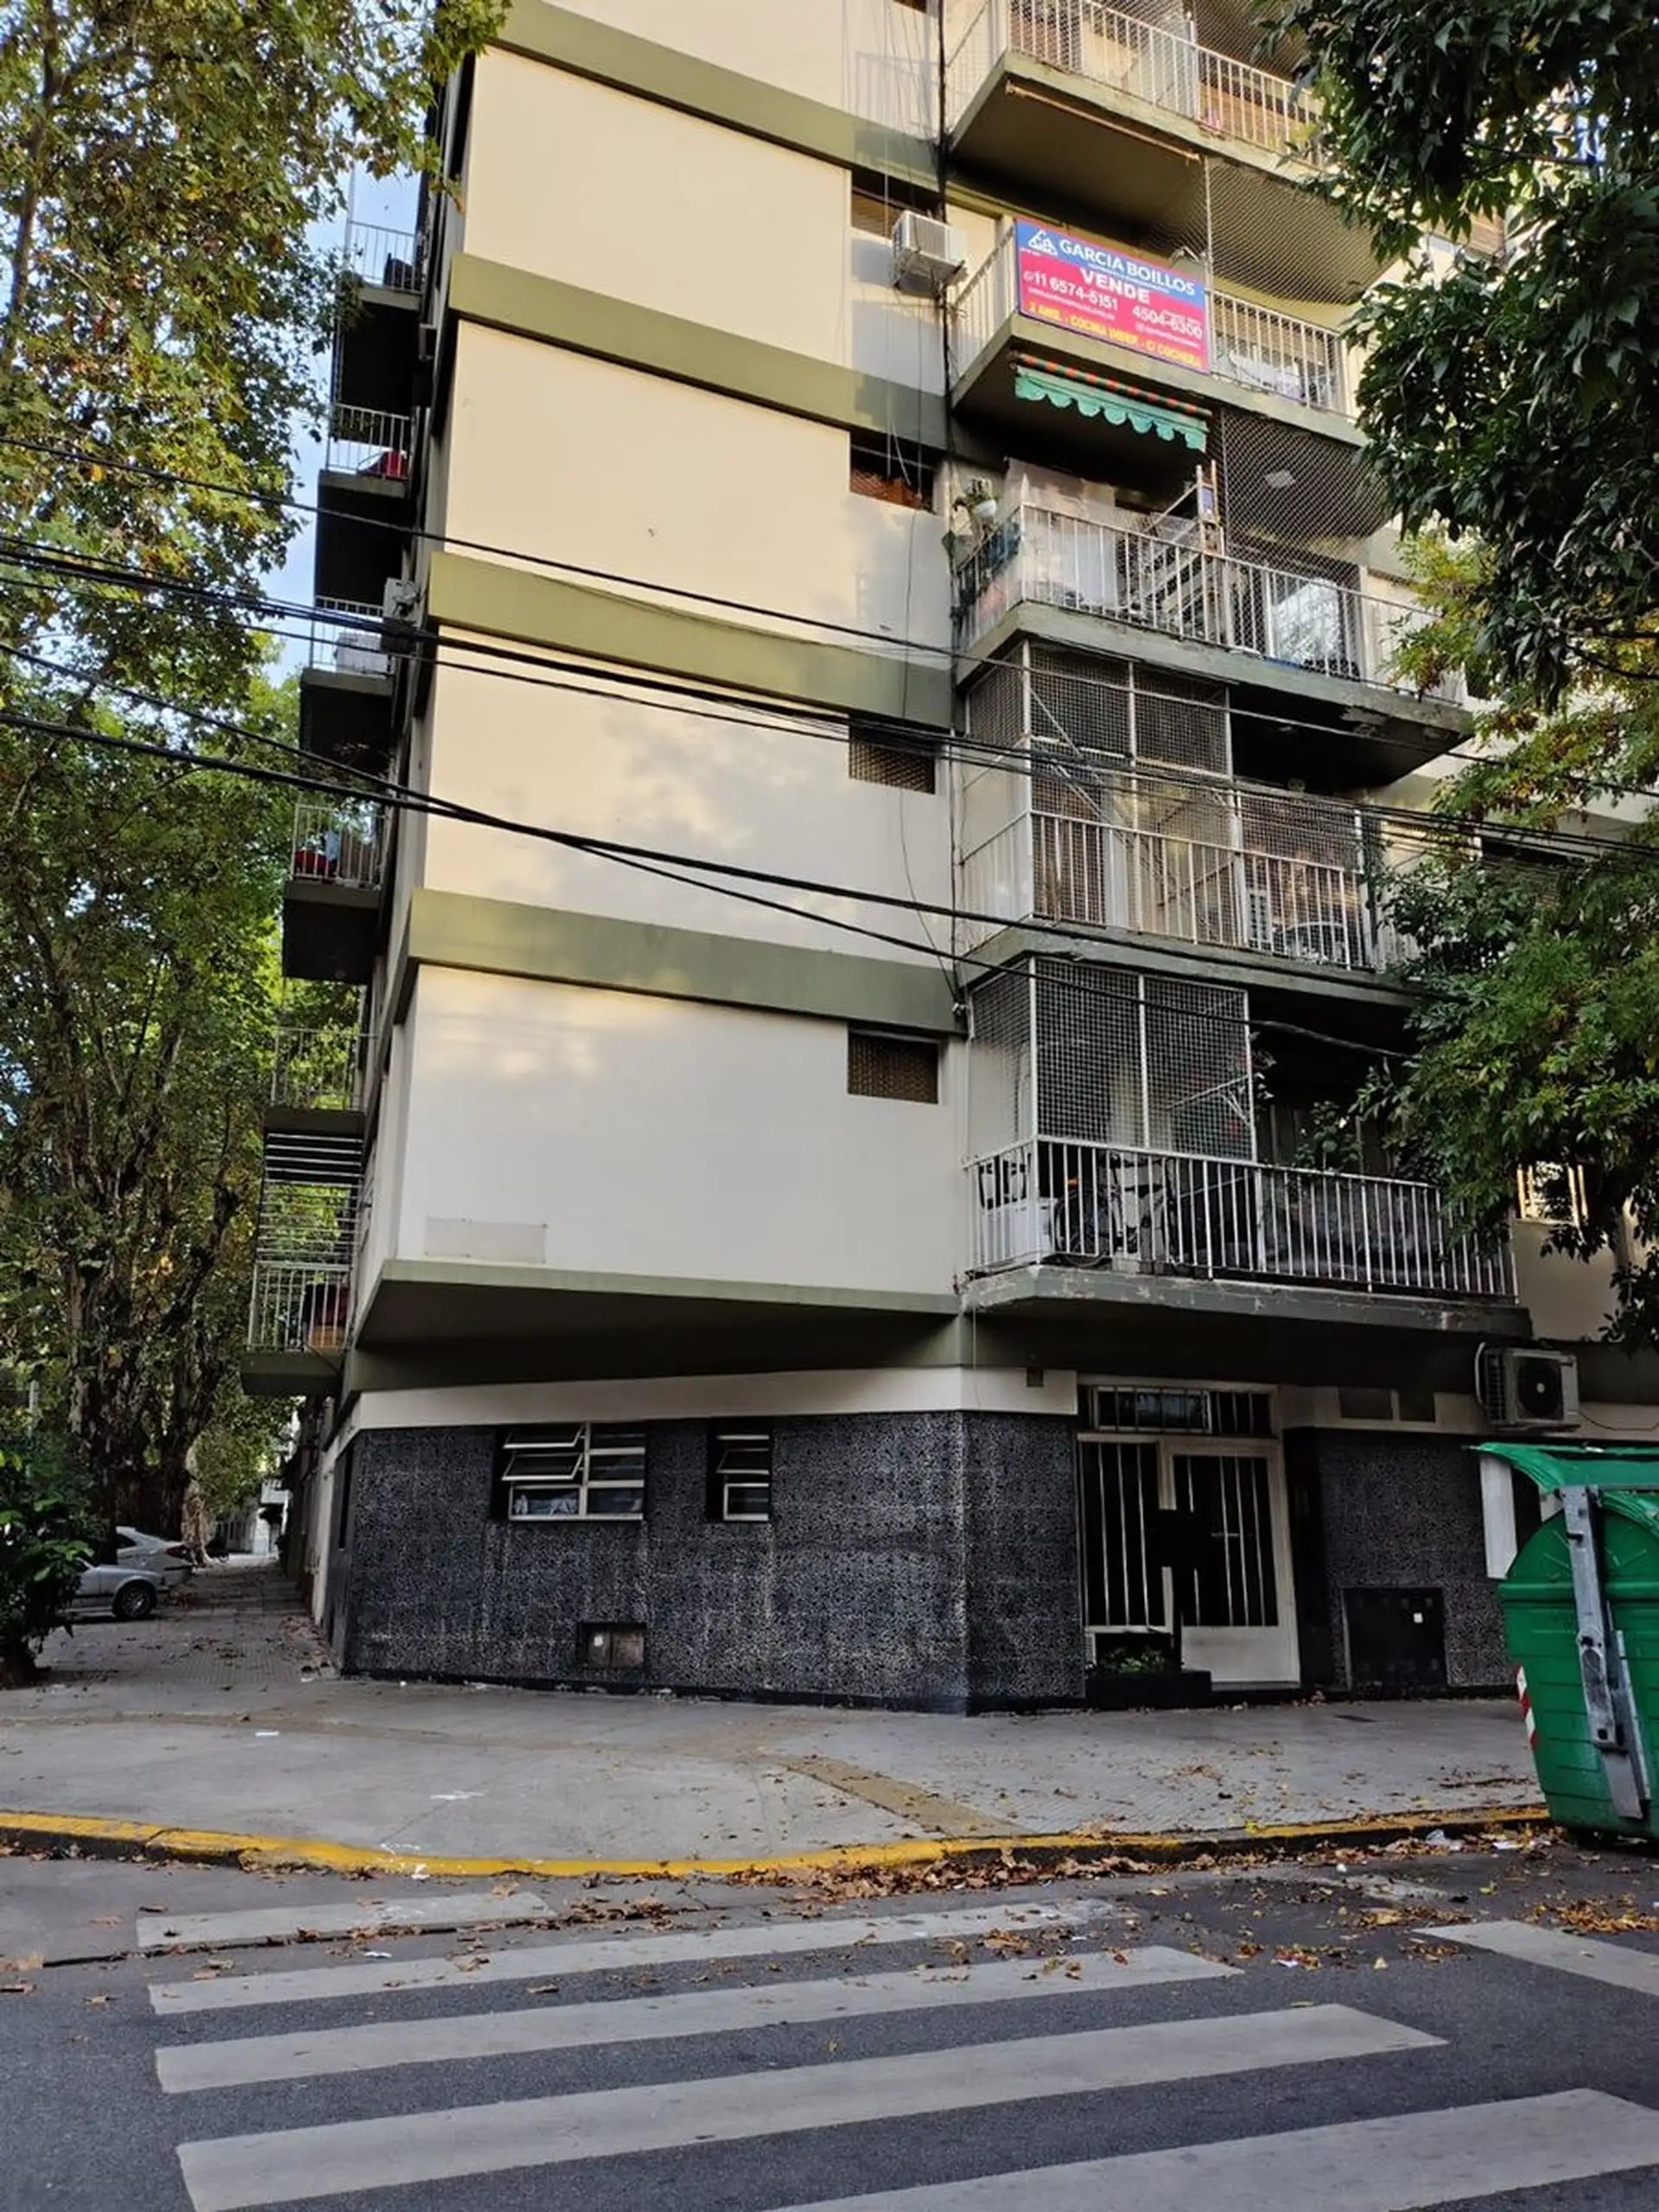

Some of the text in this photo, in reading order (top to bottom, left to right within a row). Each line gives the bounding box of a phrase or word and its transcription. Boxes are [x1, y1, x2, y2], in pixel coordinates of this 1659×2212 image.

[1035, 272, 1046, 286] 11
[1059, 239, 1123, 270] GARCIA
[1127, 260, 1195, 296] BOILLOS
[1079, 268, 1150, 304] VENDE
